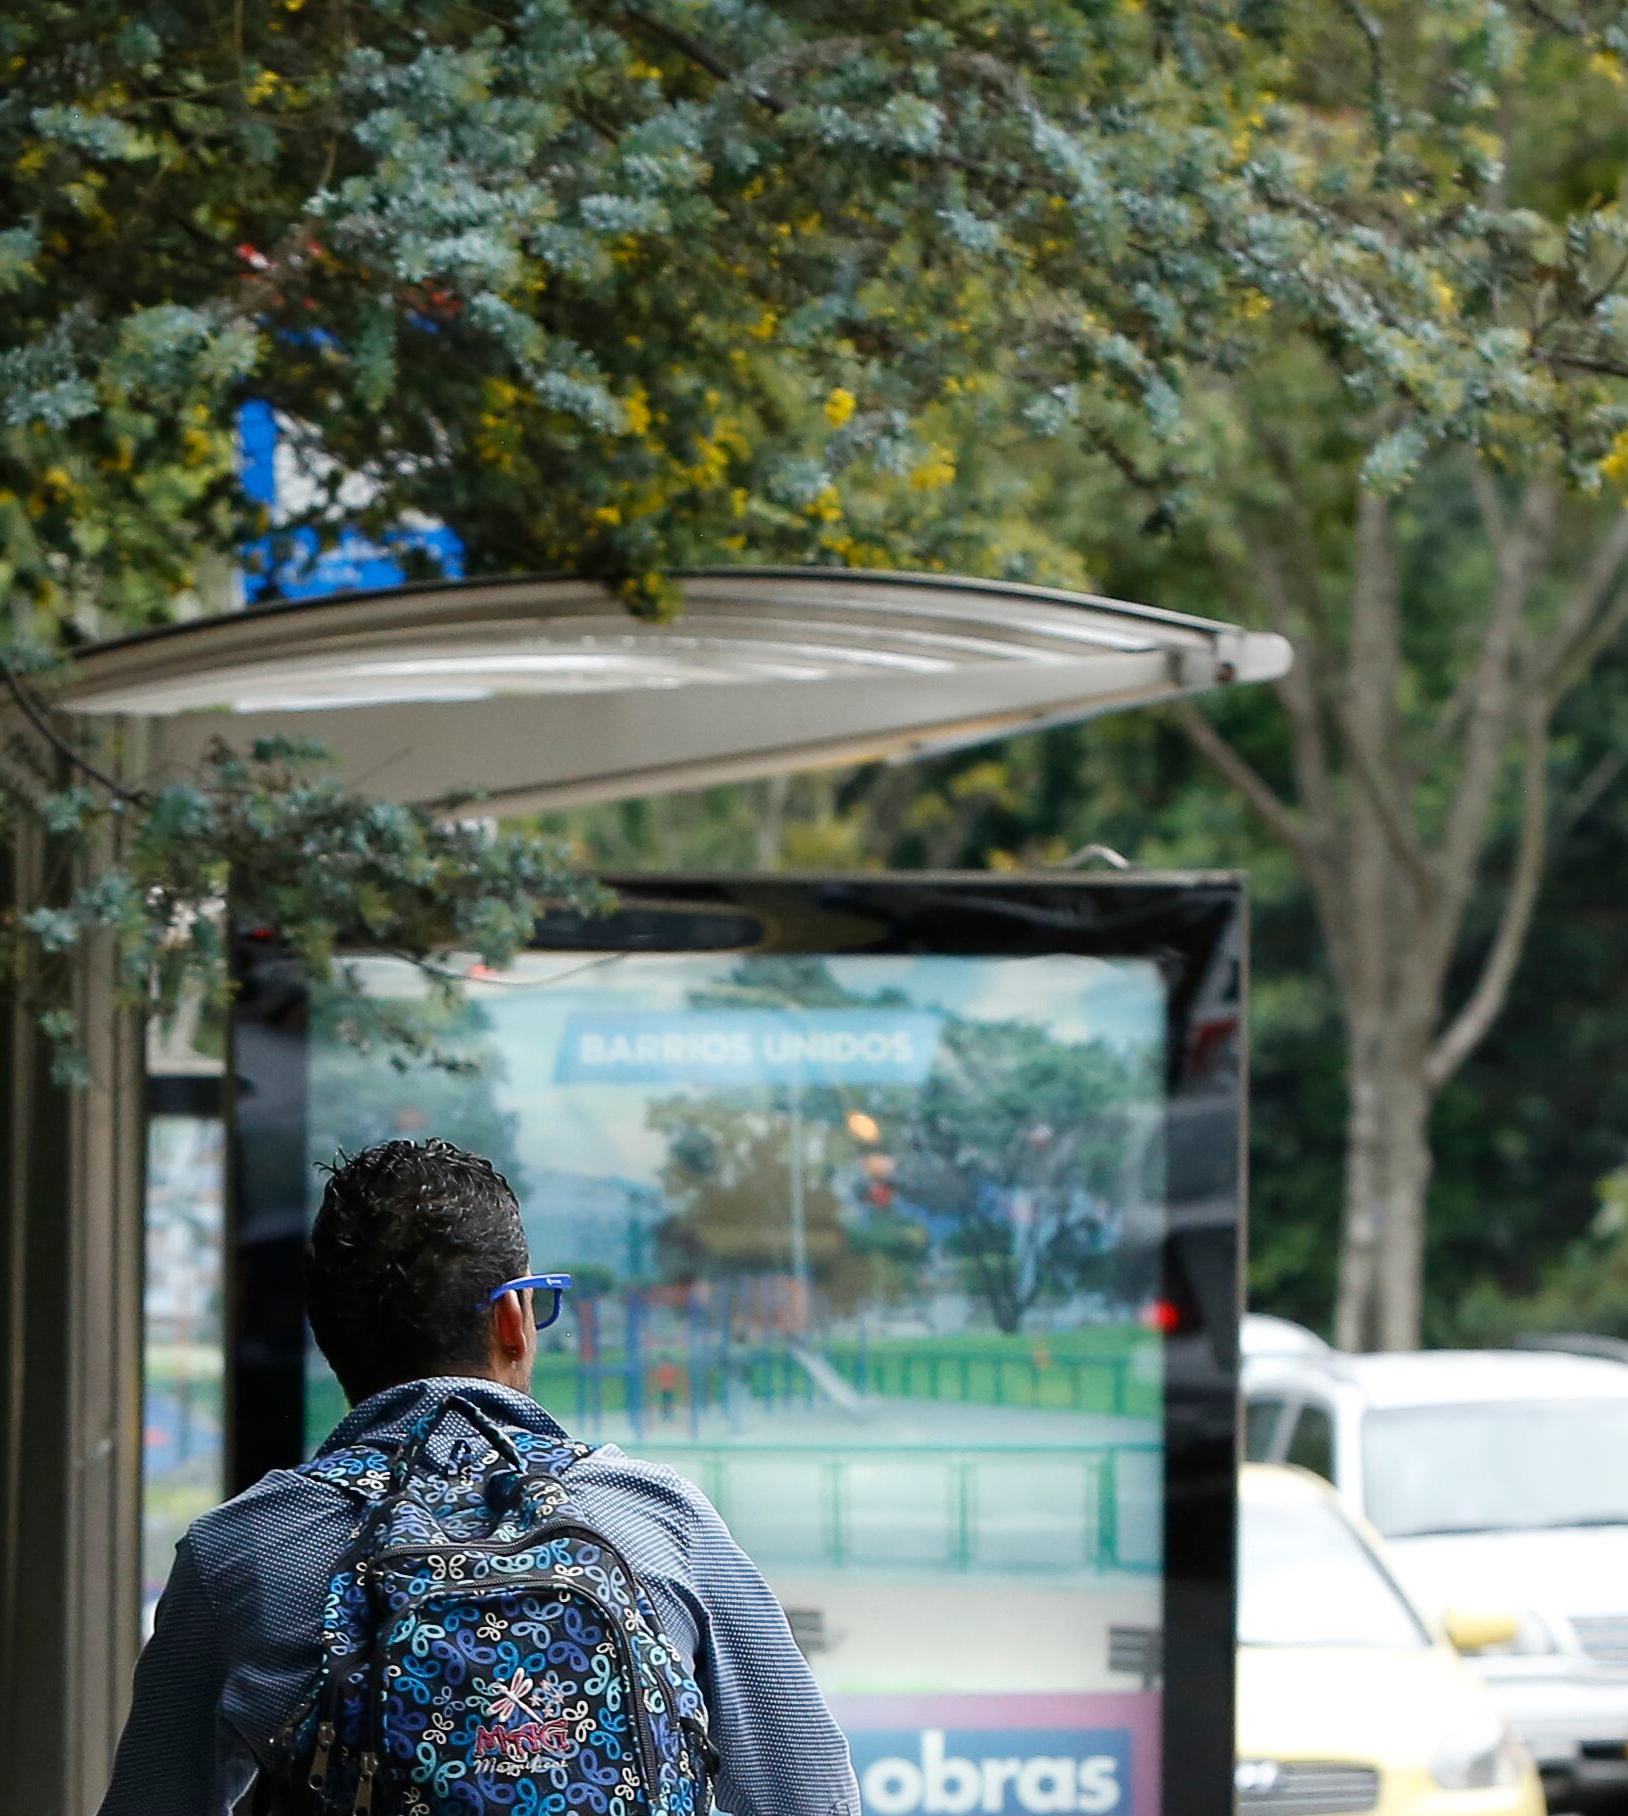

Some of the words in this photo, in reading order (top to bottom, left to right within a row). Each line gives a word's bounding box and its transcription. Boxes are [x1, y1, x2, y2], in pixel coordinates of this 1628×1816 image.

[580, 1031, 753, 1064] BARRIOS
[764, 1031, 914, 1064] UNIDOS
[863, 1728, 1123, 1816] obras
